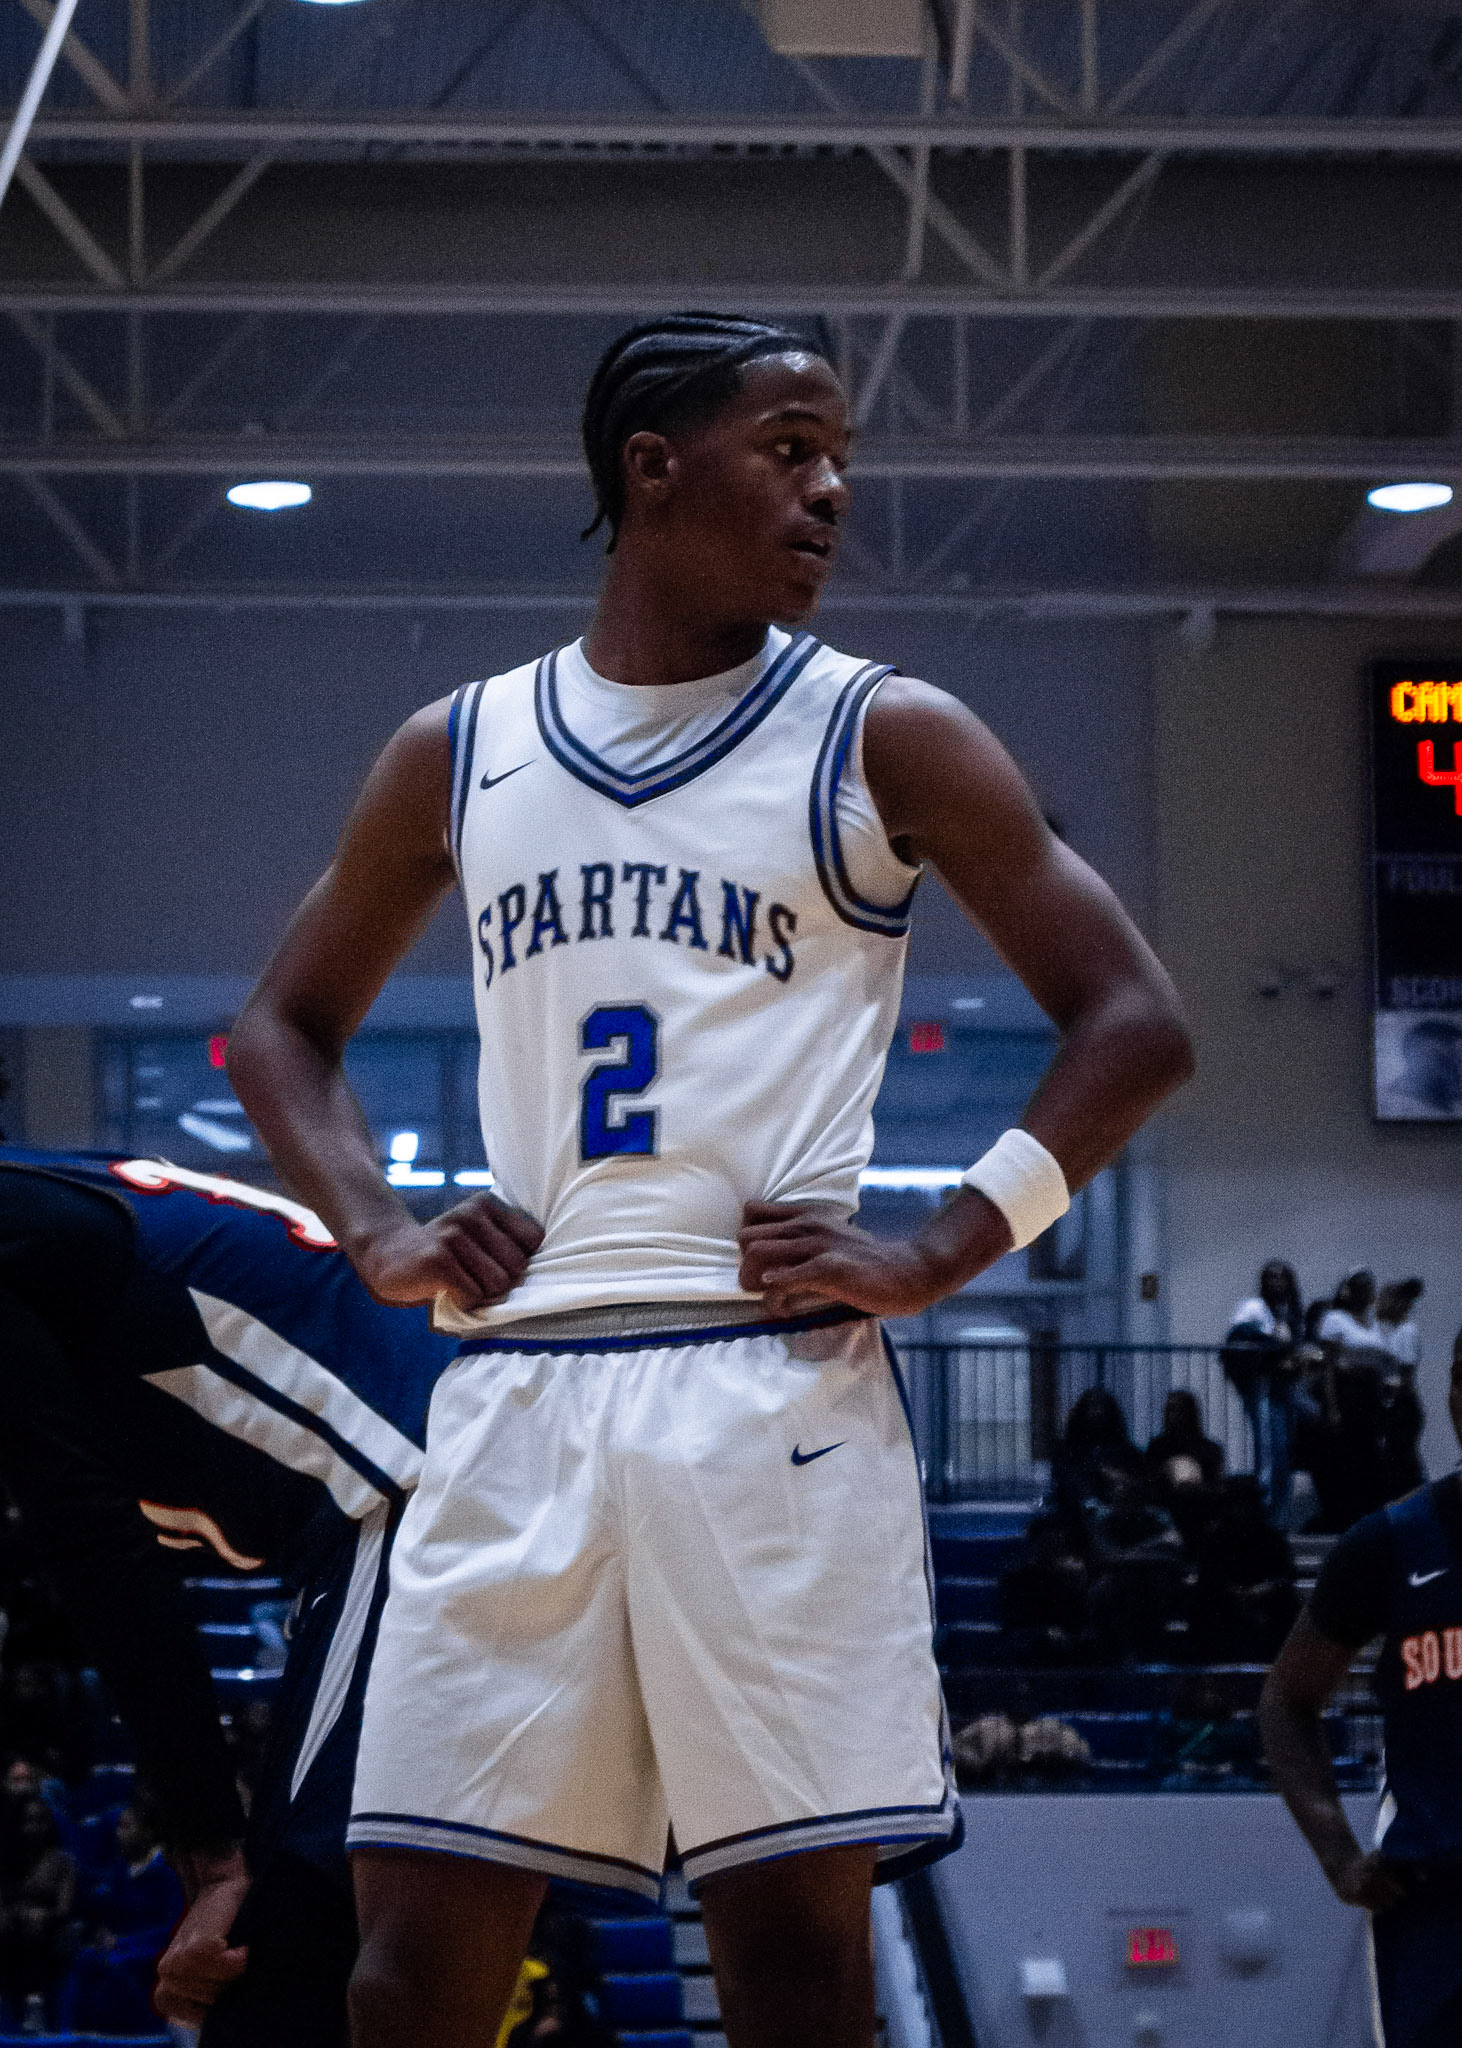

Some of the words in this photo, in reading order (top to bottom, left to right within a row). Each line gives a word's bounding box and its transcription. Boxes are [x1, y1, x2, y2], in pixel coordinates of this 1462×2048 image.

[478, 861, 797, 990] SPARTANS
[577, 1000, 661, 1167] 2
[1401, 1626, 1462, 1690] SOU
